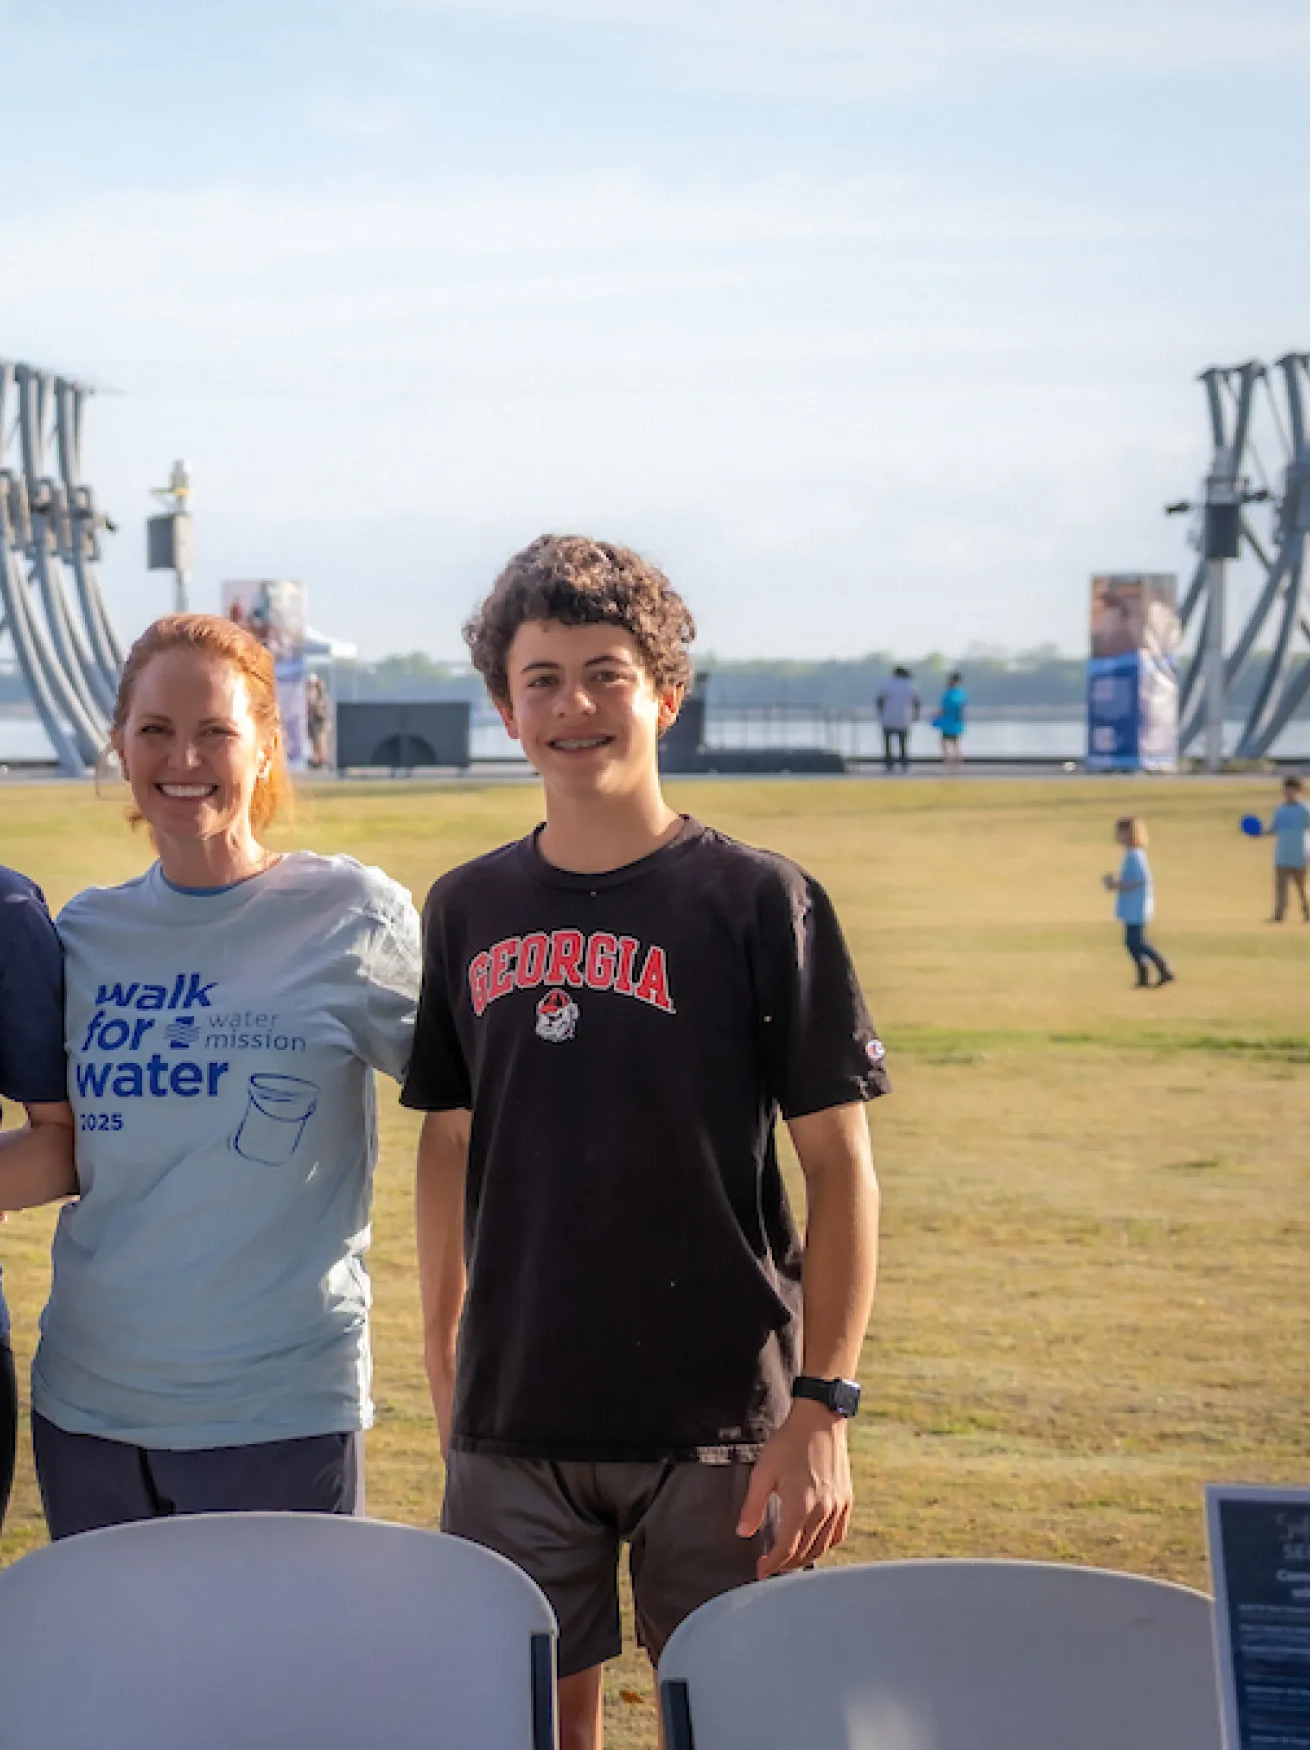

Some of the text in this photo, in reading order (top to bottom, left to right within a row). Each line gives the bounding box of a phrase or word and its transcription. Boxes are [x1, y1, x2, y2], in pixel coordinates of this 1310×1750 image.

[95, 973, 218, 1010] walk
[469, 929, 677, 1017] GEORGIA
[82, 1010, 156, 1052] for
[208, 1011, 280, 1028] water
[204, 1027, 306, 1052] mission
[76, 1054, 230, 1098] water
